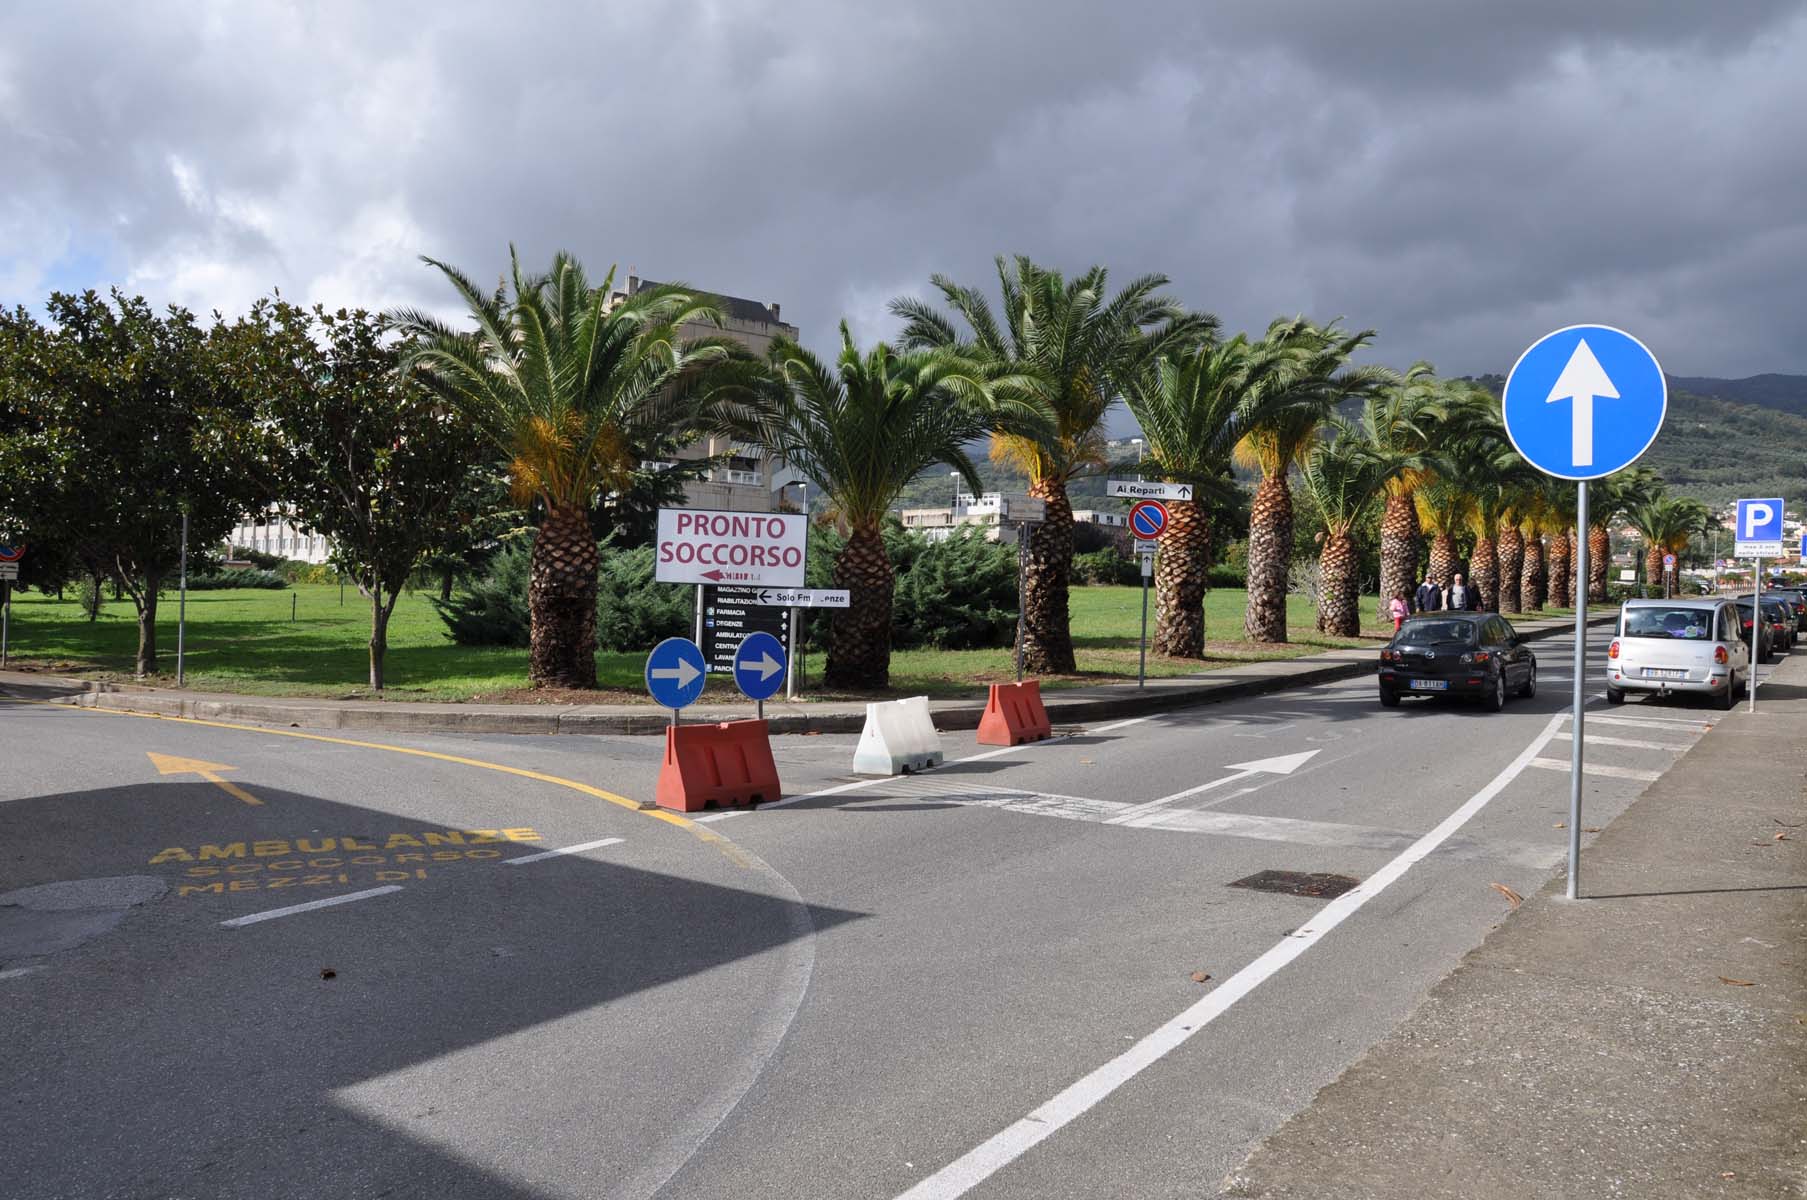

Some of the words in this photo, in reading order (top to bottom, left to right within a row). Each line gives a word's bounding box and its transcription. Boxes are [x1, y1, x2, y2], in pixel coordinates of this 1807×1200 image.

[1117, 485, 1127, 493] Ai
[1129, 485, 1165, 496] Reparti
[677, 513, 786, 539] PRONTO
[1745, 503, 1774, 538] P
[660, 541, 802, 568] SOCCORSO
[717, 597, 758, 605] RIABILITAZION
[776, 593, 795, 602] Solo
[716, 608, 746, 616] FARMACIA
[716, 620, 744, 628] DEGENZE
[715, 631, 750, 639] AMBULATO
[714, 642, 739, 650] CENTRA
[147, 827, 544, 865] AMBULANZE
[185, 849, 503, 878] SOCCORSO
[178, 873, 350, 897] MEZZI
[375, 868, 429, 881] DI
